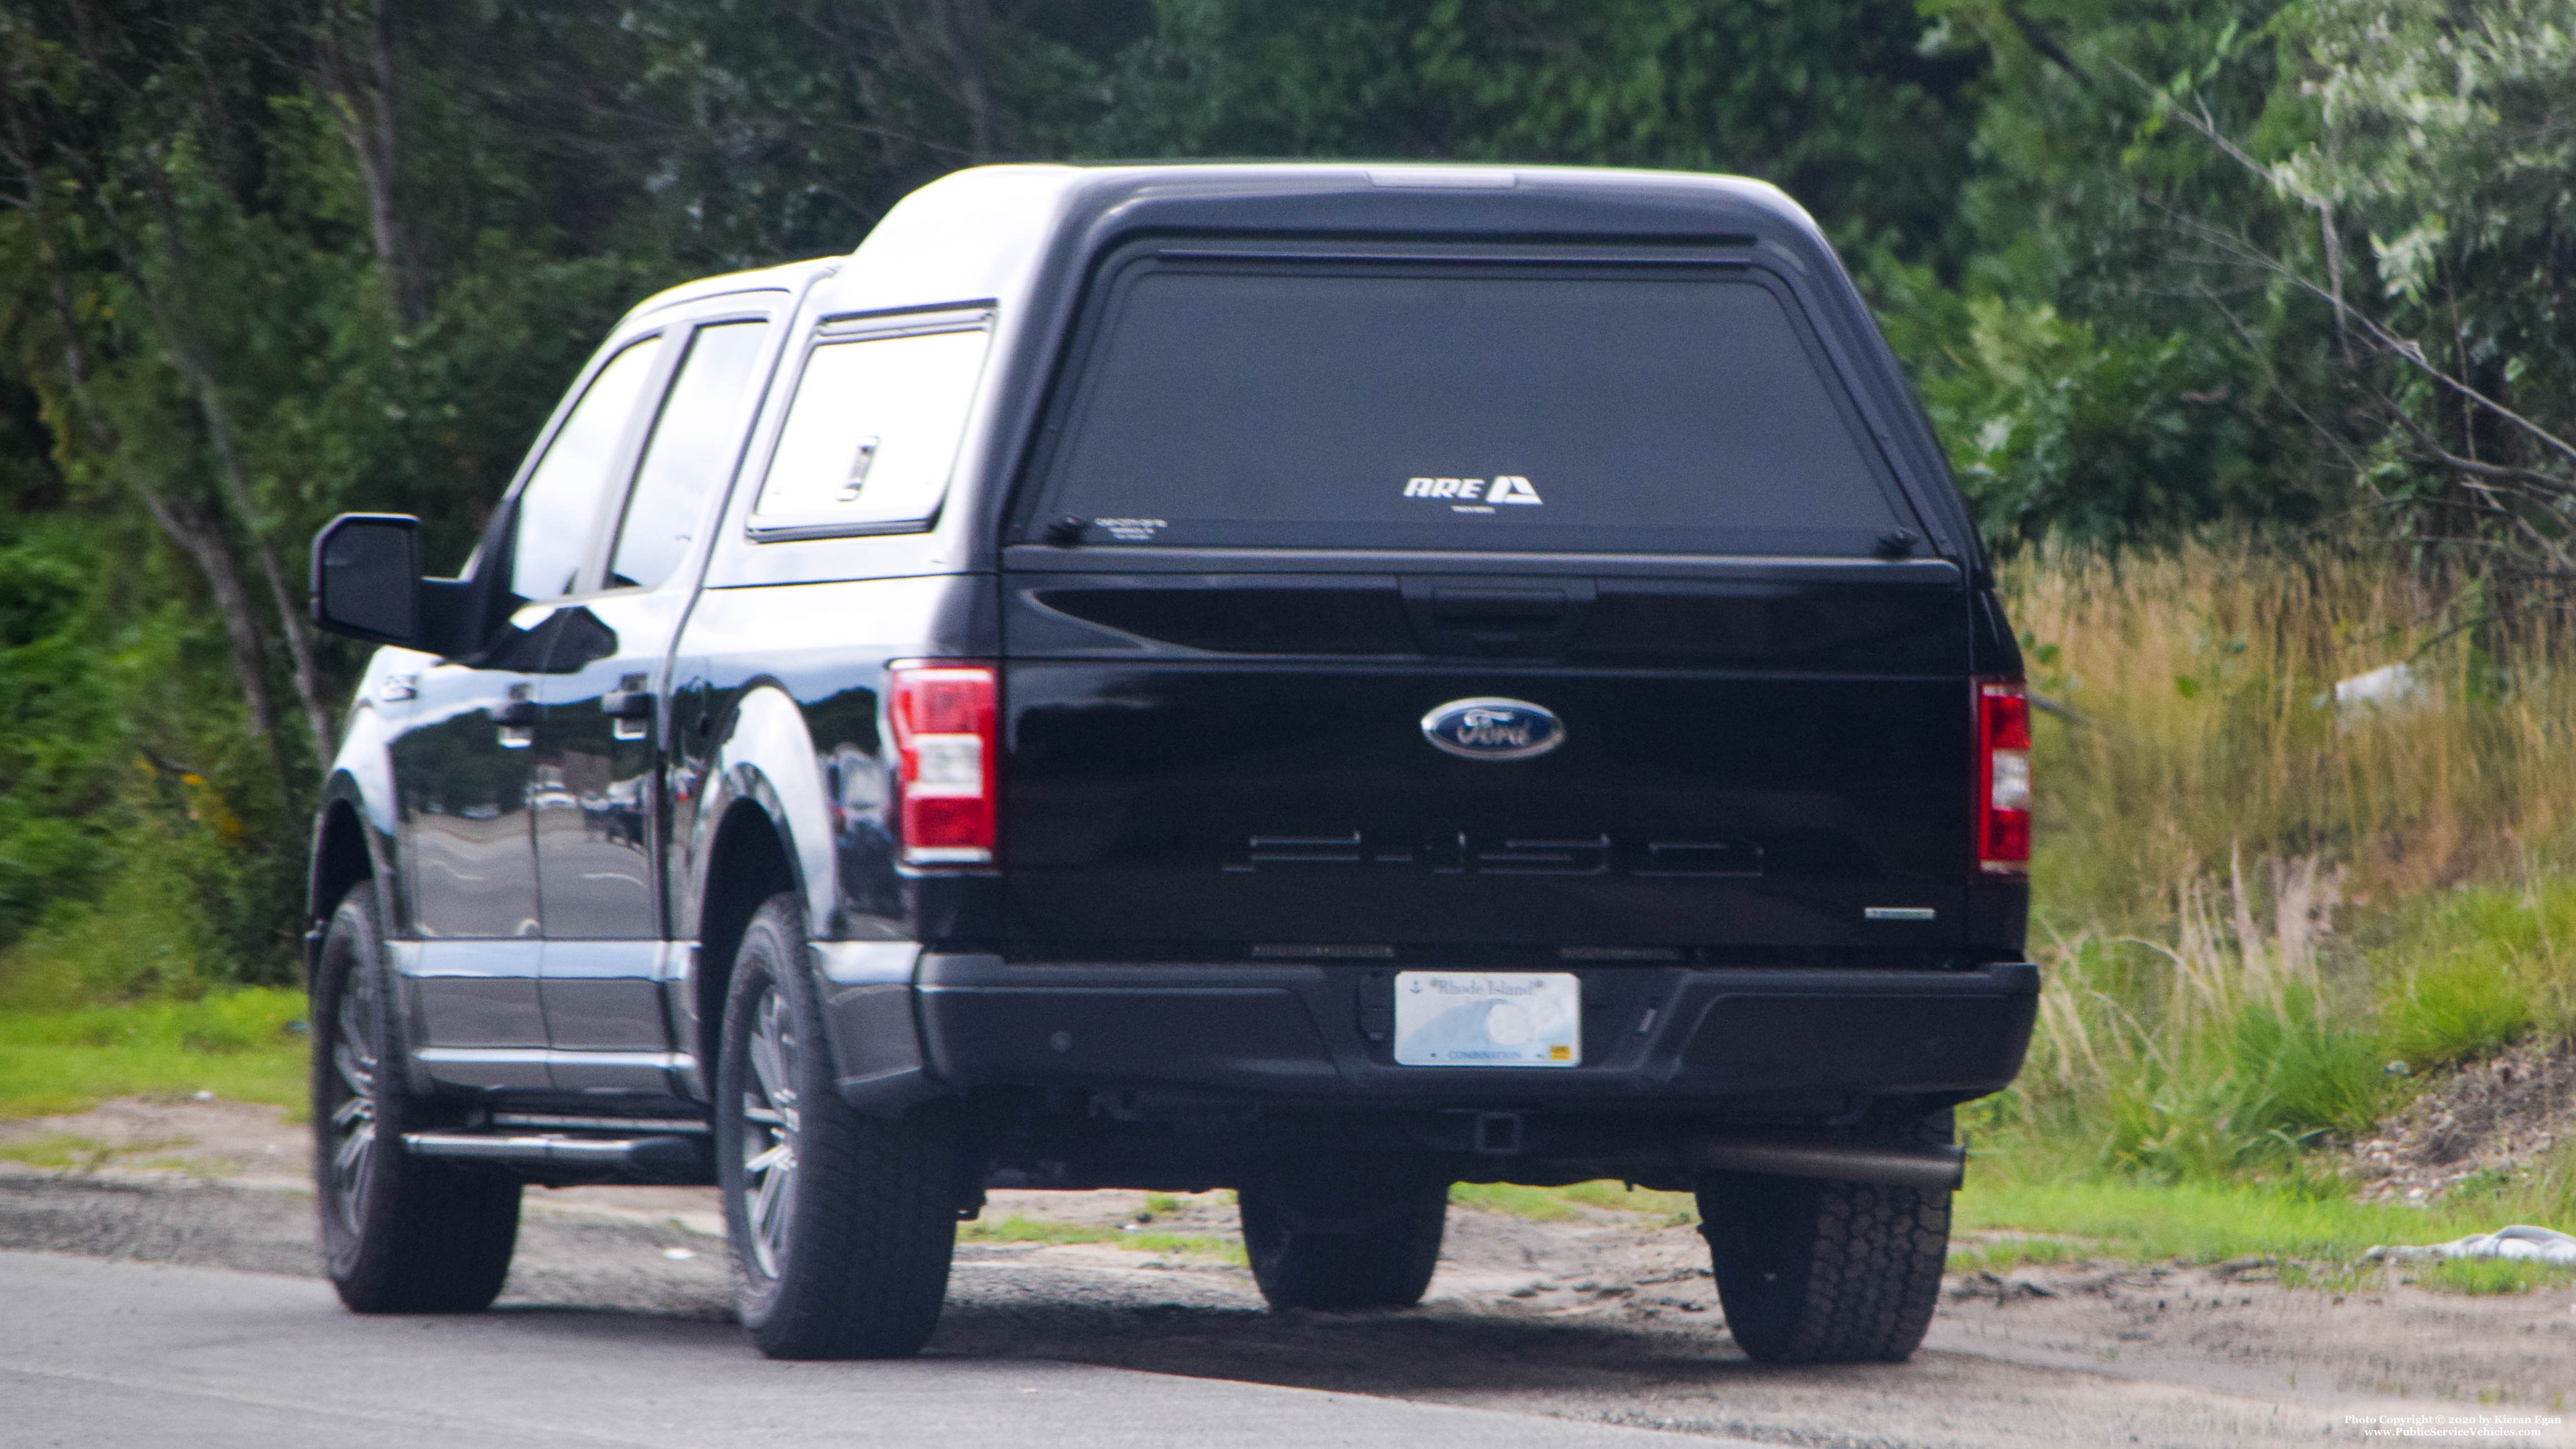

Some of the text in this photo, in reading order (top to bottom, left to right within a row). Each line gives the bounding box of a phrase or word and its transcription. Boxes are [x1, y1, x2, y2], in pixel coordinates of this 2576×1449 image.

[1403, 477, 1485, 499] ARE
[1457, 709, 1533, 745] Ford
[1439, 979, 1534, 995] Rhode Island
